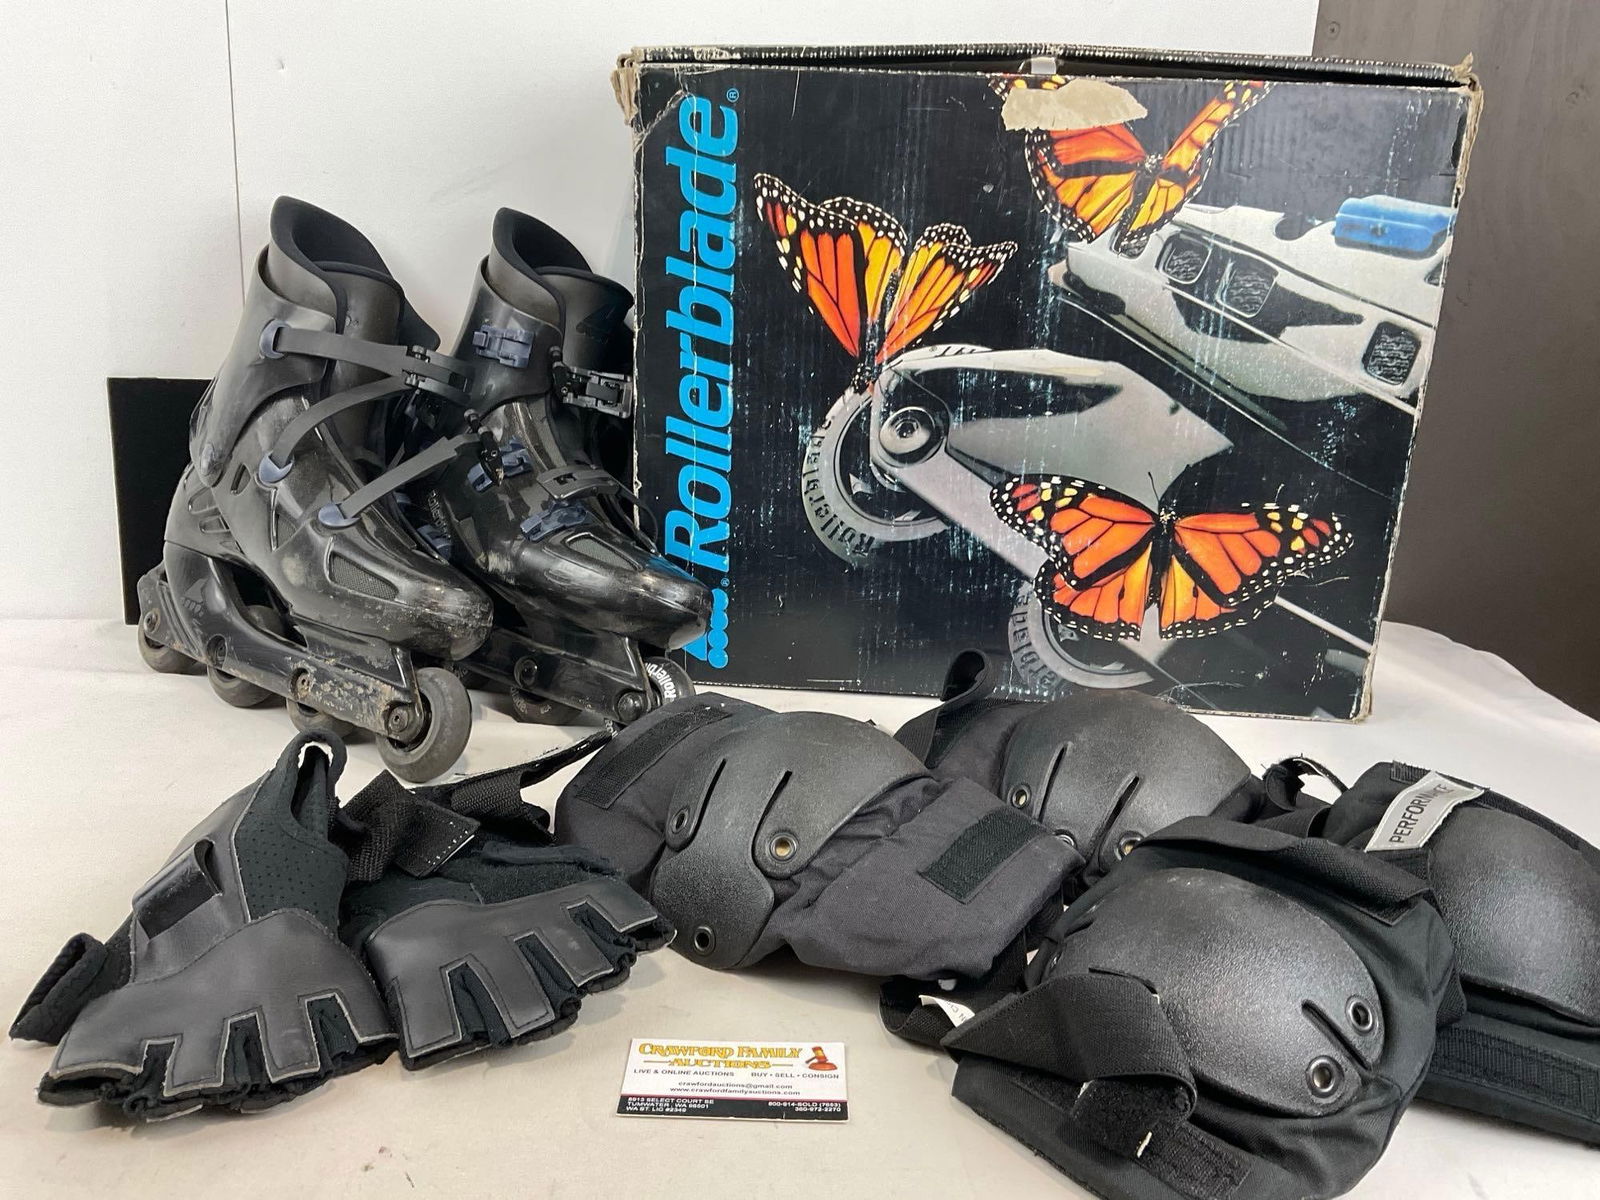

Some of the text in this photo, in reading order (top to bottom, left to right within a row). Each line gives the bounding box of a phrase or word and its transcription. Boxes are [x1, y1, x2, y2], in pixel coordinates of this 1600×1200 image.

[645, 662, 677, 700] Rollerbl
[1388, 783, 1454, 843] PERFORMCE
[638, 1043, 803, 1059] CRAWFORD FAMILY
[668, 1058, 772, 1069] AUCTIONS
